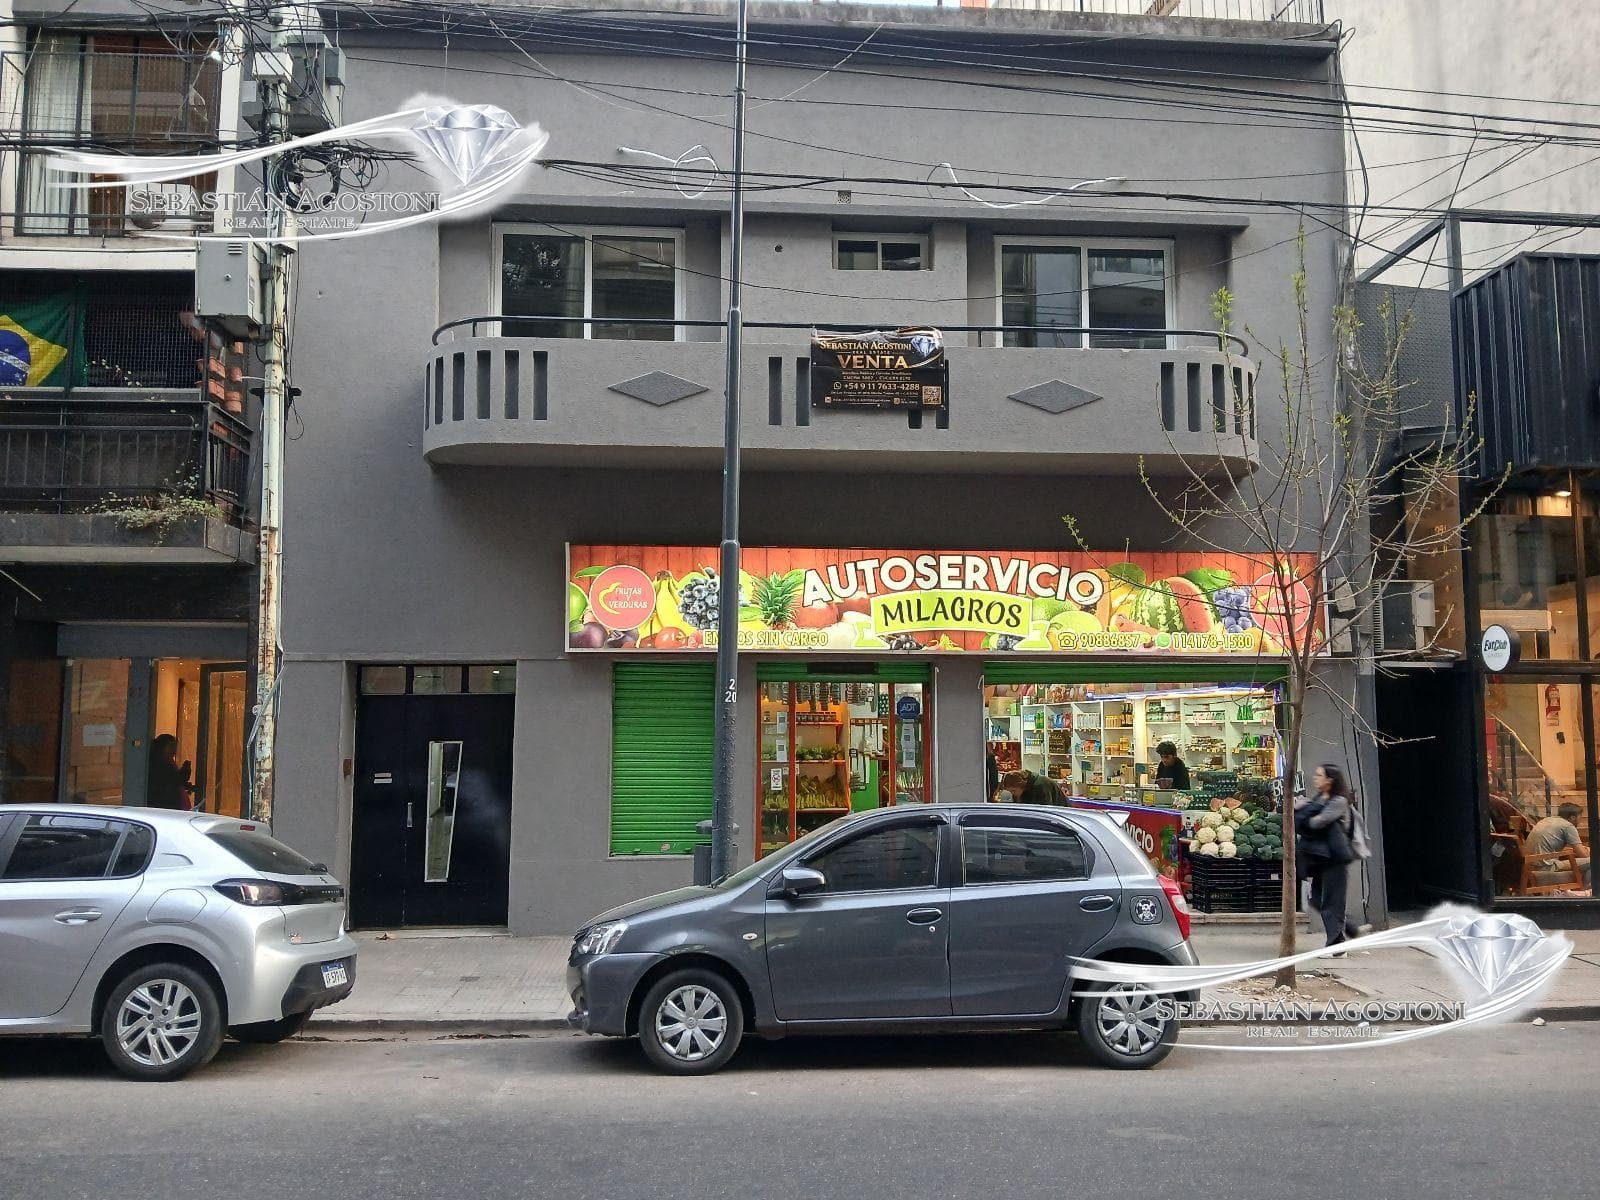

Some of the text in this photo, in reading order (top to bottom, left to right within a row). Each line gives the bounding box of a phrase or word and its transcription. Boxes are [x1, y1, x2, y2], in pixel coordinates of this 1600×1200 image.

[871, 341, 912, 351] AGOSTONI
[837, 355, 910, 369] VENTA
[844, 382, 920, 391] +54 9 11 7633-4288
[801, 553, 1105, 606] AUTOSERVICIO
[615, 587, 642, 595] FRUTAS
[608, 601, 649, 609] VERDURAS
[881, 597, 1024, 628] MILAGROS
[704, 631, 829, 647] ENOS SIN CARGO
[729, 678, 736, 690] 2
[725, 690, 737, 703] 20
[901, 703, 917, 712] ADT
